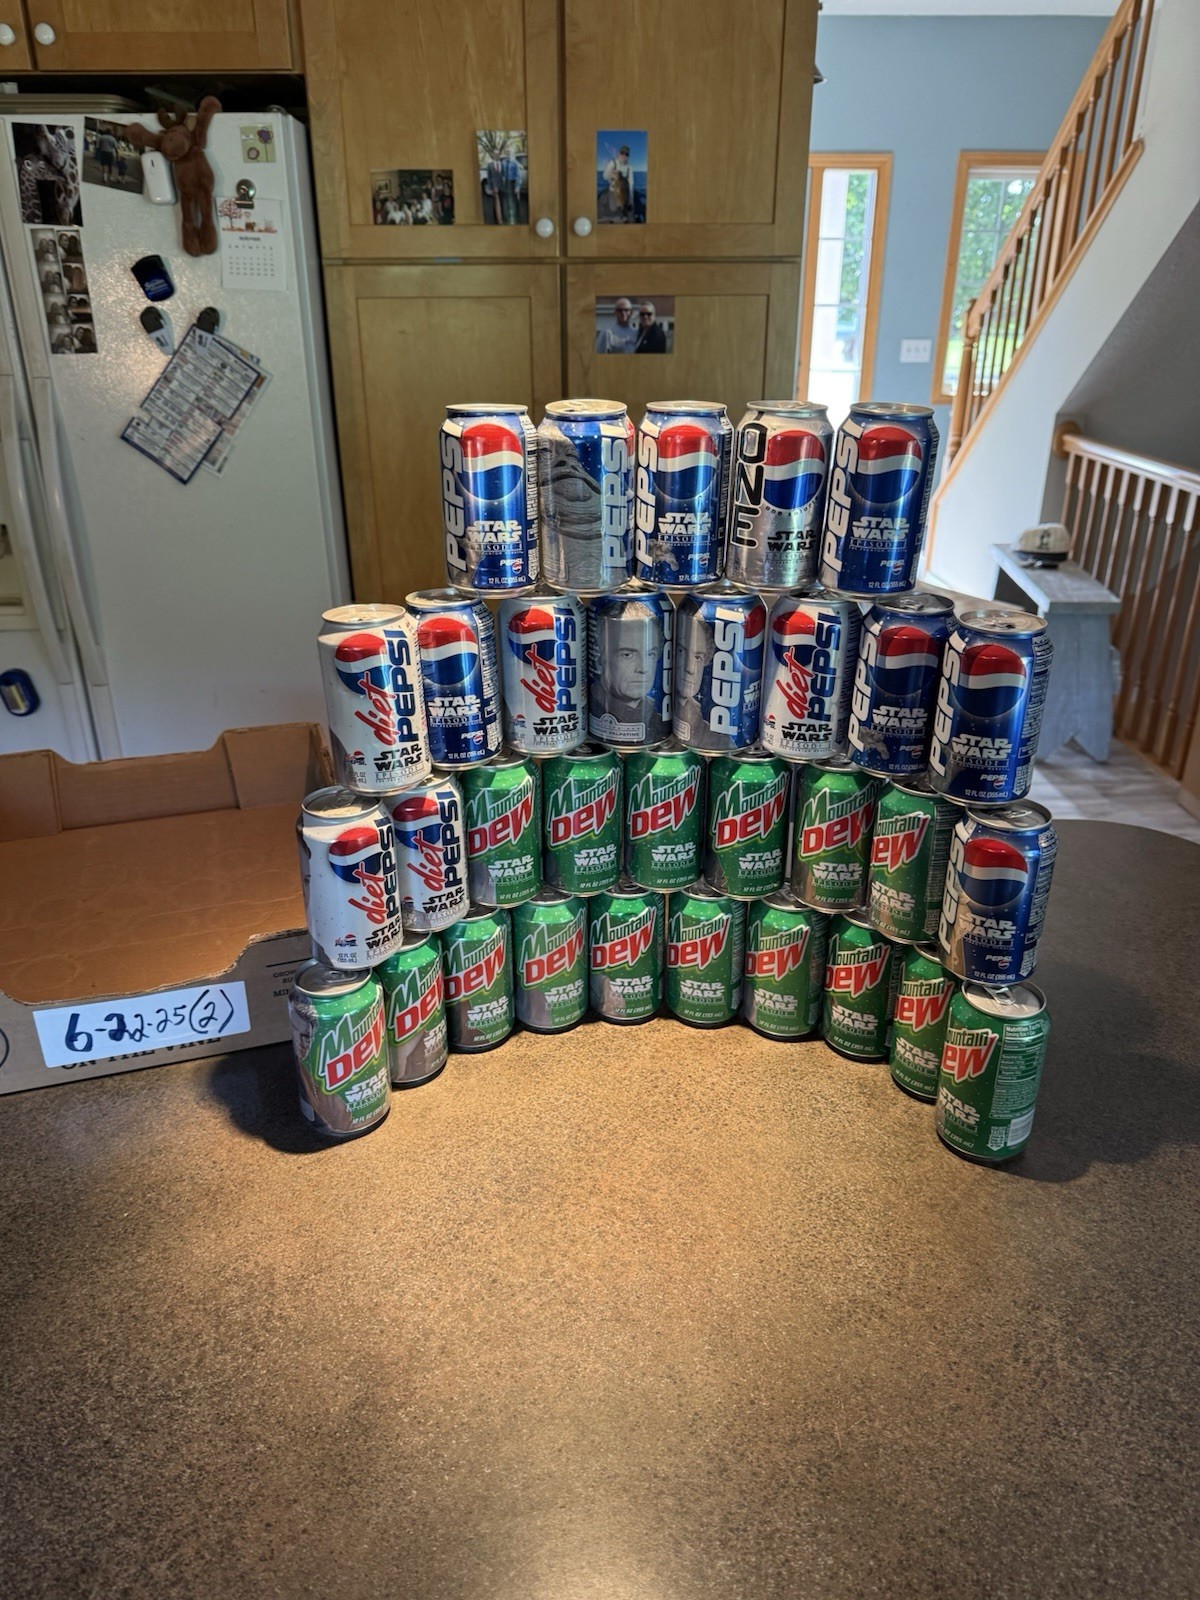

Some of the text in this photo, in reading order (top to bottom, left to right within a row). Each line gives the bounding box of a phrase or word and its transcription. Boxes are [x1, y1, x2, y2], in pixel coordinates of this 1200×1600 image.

[635, 419, 660, 567] PEPSI
[730, 421, 768, 548] ONE
[442, 419, 467, 572] PEPSI
[600, 423, 628, 568] PEPSI
[822, 419, 864, 573] PEPSI
[467, 520, 522, 531] STAR
[658, 512, 712, 523] STAR
[852, 516, 910, 528] STAR
[467, 531, 522, 542] WARS
[658, 523, 711, 534] WARS
[768, 530, 816, 540] STAR
[852, 527, 909, 540] WARS
[768, 540, 816, 552] WARS
[520, 644, 558, 713] diet
[554, 606, 577, 712] PEPSI
[776, 612, 841, 722] diet PEPSI
[710, 606, 744, 736] PEPSI
[354, 671, 400, 746] diet
[384, 630, 418, 742] PEPSI
[848, 614, 882, 752] PEPSI
[428, 694, 480, 706] STAR
[930, 630, 967, 776] PEPSI
[428, 704, 480, 716] WARS
[872, 705, 928, 718] STAR
[533, 713, 578, 726] STAR
[534, 722, 578, 735] WARS
[782, 722, 832, 732] STAR
[872, 714, 928, 728] WARS
[782, 730, 832, 742] WARS
[952, 734, 1013, 748] STAR
[374, 744, 422, 761] STAR
[952, 742, 1012, 758] WARS
[374, 752, 422, 771] WARS
[466, 775, 535, 829] Mountain
[546, 767, 620, 830] Mountain
[628, 765, 701, 824] Mountain
[712, 771, 790, 832] Mountain
[798, 780, 879, 840] Mountain
[875, 802, 924, 836] ountain
[407, 791, 462, 892] diet PEPSI
[652, 842, 696, 854] STAR
[872, 815, 932, 873] ew
[574, 844, 617, 858] STAR
[574, 851, 616, 866] WARS
[652, 848, 696, 862] WARS
[738, 848, 782, 862] STAR
[348, 861, 387, 924] diet
[374, 816, 399, 920] PEPSI
[488, 854, 534, 868] STAR
[488, 861, 534, 878] WARS
[738, 857, 782, 870] WARS
[813, 862, 863, 872] STAR
[813, 869, 862, 880] WARS
[422, 886, 464, 905] STAR
[871, 881, 916, 904] STAR
[938, 821, 971, 954] PEPSI
[423, 893, 464, 914] WARS
[590, 906, 656, 946] Mountain
[668, 911, 725, 944] Mountain
[960, 912, 1016, 930] STAR
[960, 918, 1016, 938] WARS
[746, 920, 805, 952] Mountain
[442, 924, 507, 976] Mountain
[545, 978, 584, 996] STAR
[610, 976, 653, 986] STAR
[610, 984, 652, 994] WARS
[680, 980, 724, 990] STAR
[901, 965, 945, 997] ountain
[545, 988, 584, 1003] WARS
[680, 986, 724, 998] WARS
[754, 988, 798, 1002] STAR
[467, 996, 509, 1014] STAR
[754, 994, 798, 1010] WARS
[894, 981, 954, 1032] ew
[467, 1004, 508, 1021] WARS
[832, 1005, 878, 1022] STAR
[832, 1010, 878, 1030] WARS
[948, 1027, 992, 1046] untain
[896, 1038, 939, 1062] STAR
[942, 1033, 999, 1084] ew
